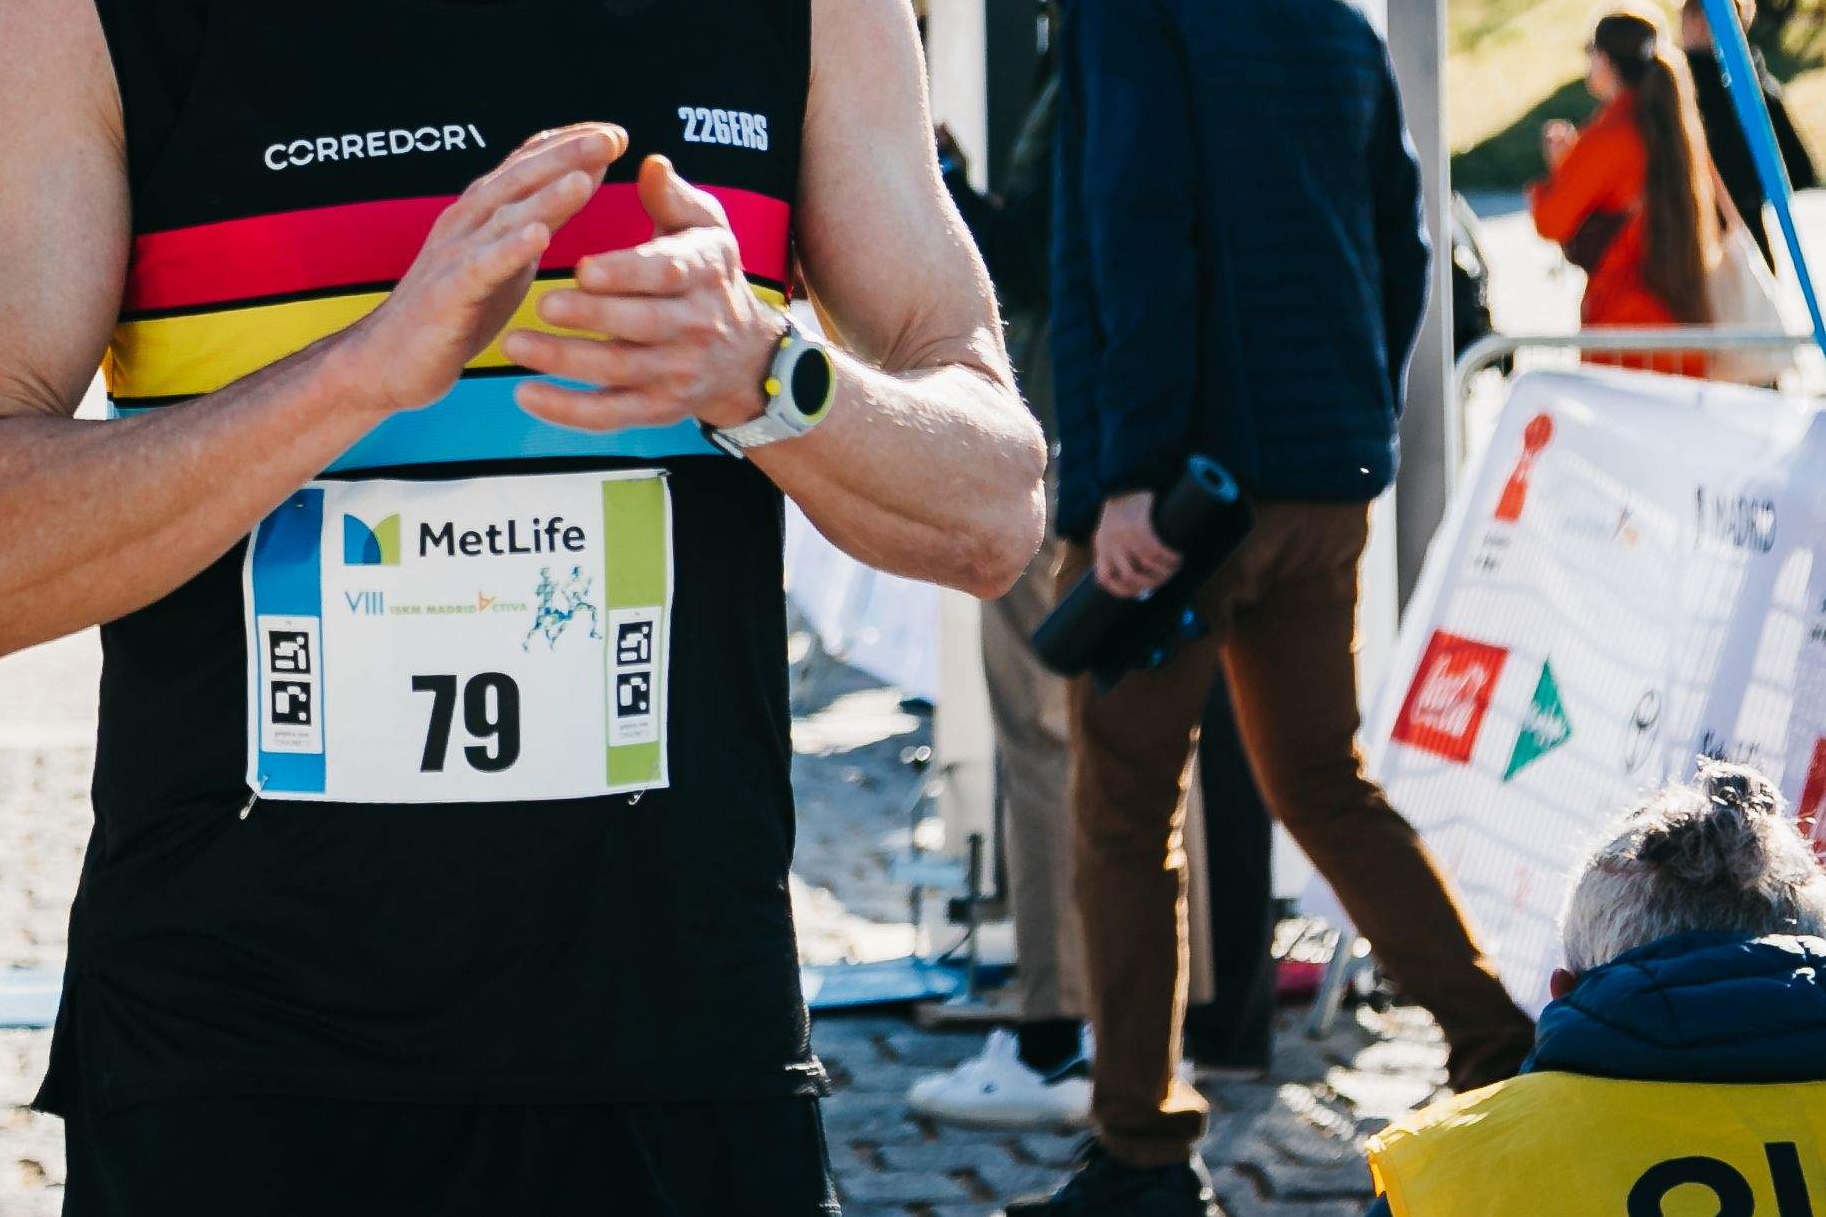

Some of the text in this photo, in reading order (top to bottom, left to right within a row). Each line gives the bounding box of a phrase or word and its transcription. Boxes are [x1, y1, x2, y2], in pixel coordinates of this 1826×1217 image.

[677, 106, 768, 152] 226ERS
[418, 516, 586, 558] MetLife
[344, 591, 385, 616] VIII
[411, 671, 521, 774] 79
